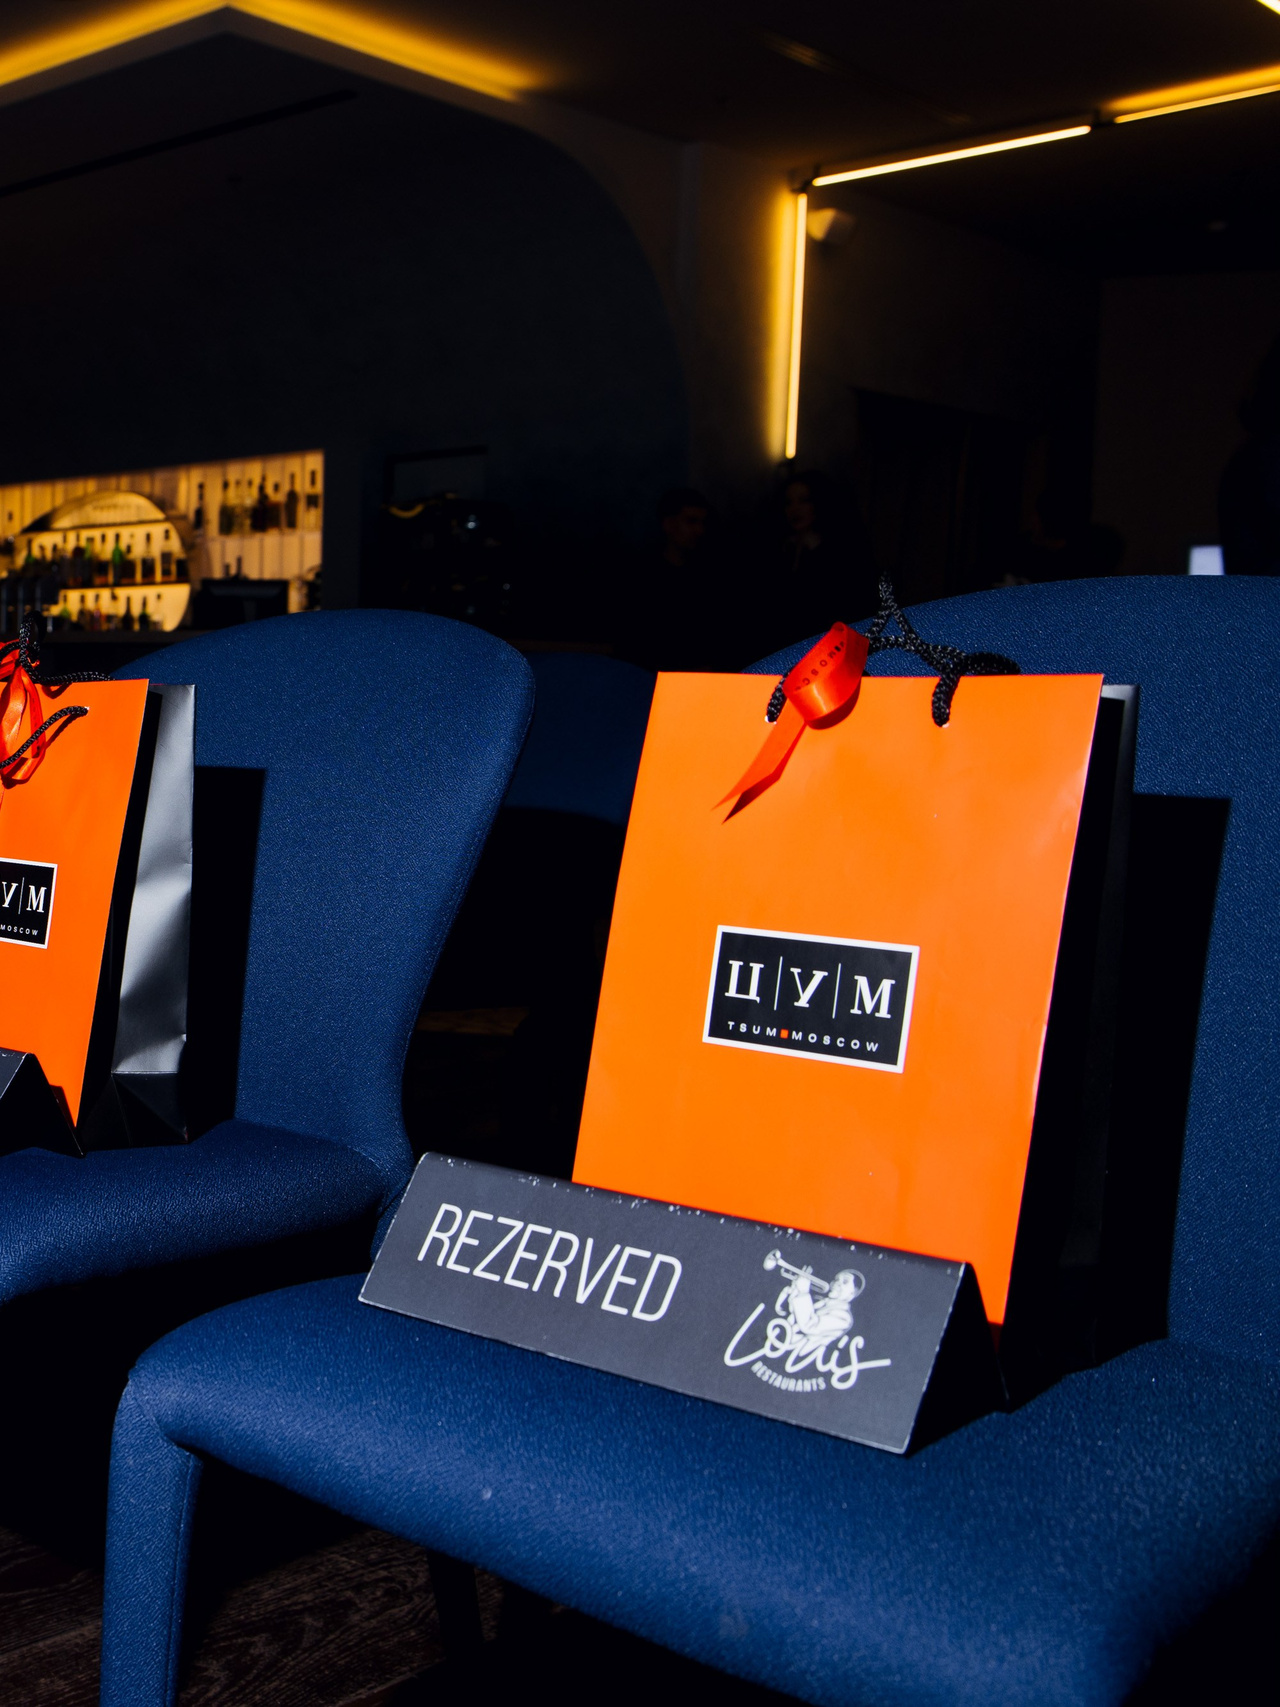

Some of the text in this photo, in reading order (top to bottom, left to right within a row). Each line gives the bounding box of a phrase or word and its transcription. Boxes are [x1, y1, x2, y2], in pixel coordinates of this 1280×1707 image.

[0, 923, 39, 936] MOSCOW
[727, 1020, 879, 1052] TSUM MOSCOW
[416, 1202, 683, 1323] REZERVED
[750, 1360, 827, 1393] RESTAURANTS
